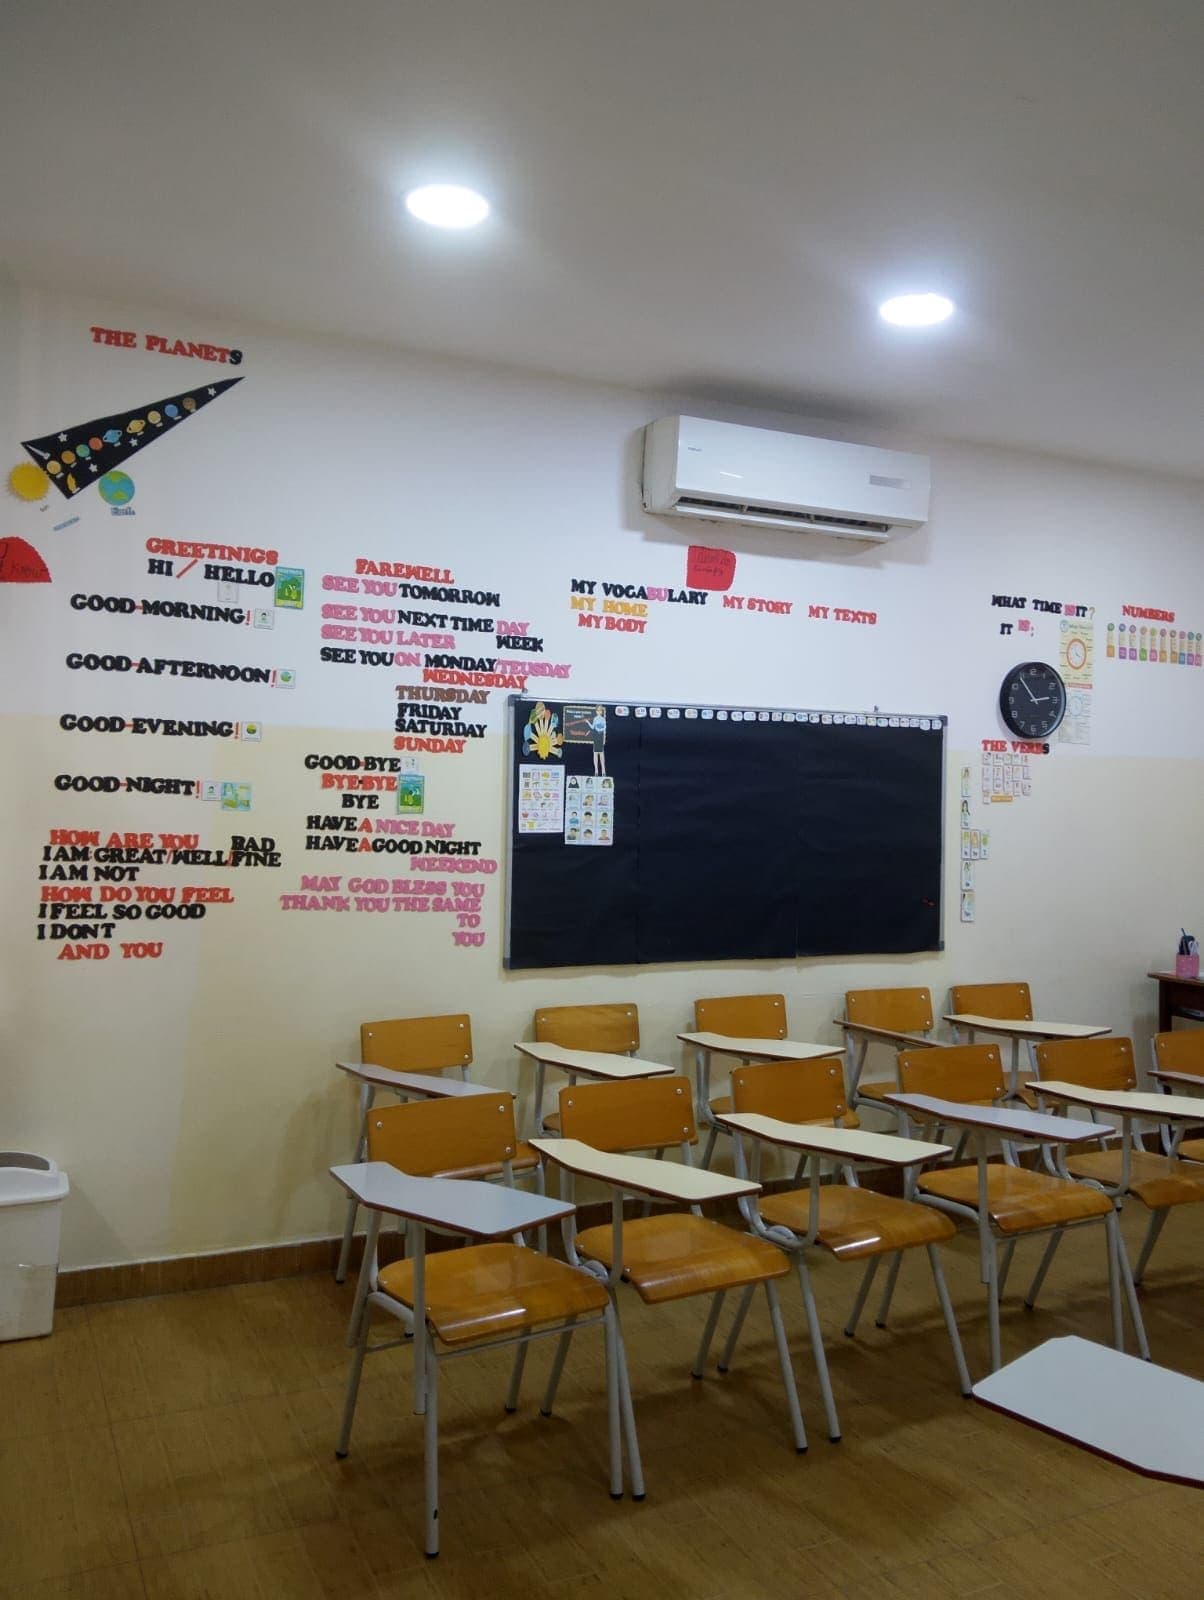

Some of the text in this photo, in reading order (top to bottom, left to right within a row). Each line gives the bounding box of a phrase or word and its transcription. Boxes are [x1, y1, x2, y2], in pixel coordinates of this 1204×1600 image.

[91, 327, 243, 365] THE PLANETS
[148, 559, 174, 577] HI
[204, 564, 275, 587] HELLO
[355, 558, 455, 584] FAREWELL
[321, 575, 501, 607] SEE YOU TOMORROW
[571, 579, 596, 595] MY
[70, 594, 251, 626] GOOD-MORNING!
[570, 596, 648, 618] MY HOME
[722, 595, 793, 615] MY STORY
[991, 595, 1027, 609] WHAT
[1032, 599, 1062, 614] TIME
[1122, 605, 1175, 623] NUMBERS
[321, 604, 530, 636] SEE YOU NEXT TIME DAY
[578, 613, 647, 634] MY BODY
[807, 605, 877, 625] MY TEXTS
[320, 624, 456, 650] SEE YOU LATER
[1000, 623, 1013, 635] IT
[496, 634, 543, 652] WEEK
[320, 647, 356, 663] SEE
[359, 649, 395, 666] YOU
[395, 652, 421, 668] ON
[66, 653, 277, 688] GOOD-AFTERNOON!
[423, 668, 528, 690] WEDNESDAY
[395, 685, 491, 704] THURSDAY
[397, 703, 462, 721] FRIDAY
[60, 714, 240, 740] GOOD-EVENING!
[394, 719, 487, 738] SATURDAY
[393, 735, 467, 754] SUNDAY
[981, 739, 1050, 755] THE VERBS
[304, 754, 401, 772] GOOD-BYE
[54, 774, 201, 799] GOOD-NIGHT!
[321, 773, 398, 791] BYE-BYE
[341, 794, 379, 809] BYE
[306, 815, 456, 838] HAVE A NICE DAY
[50, 829, 199, 849] HOW ARE YOU
[231, 836, 276, 852] BAD
[305, 835, 482, 855] HAVE A GOOD NIGHT
[43, 845, 52, 861] I
[39, 864, 140, 882] I AM NOT
[410, 857, 498, 874] WEEKEND
[41, 886, 234, 903] HOW DO YOU FEEL
[301, 875, 485, 897] MAY GOD BLESS YOU
[38, 903, 206, 920] I FEEL SO GOOD
[280, 894, 482, 913] THANK YOU THE SAME
[456, 913, 481, 928] TO
[37, 924, 46, 940] I
[452, 932, 485, 947] YOU
[57, 942, 163, 960] AND YOU
